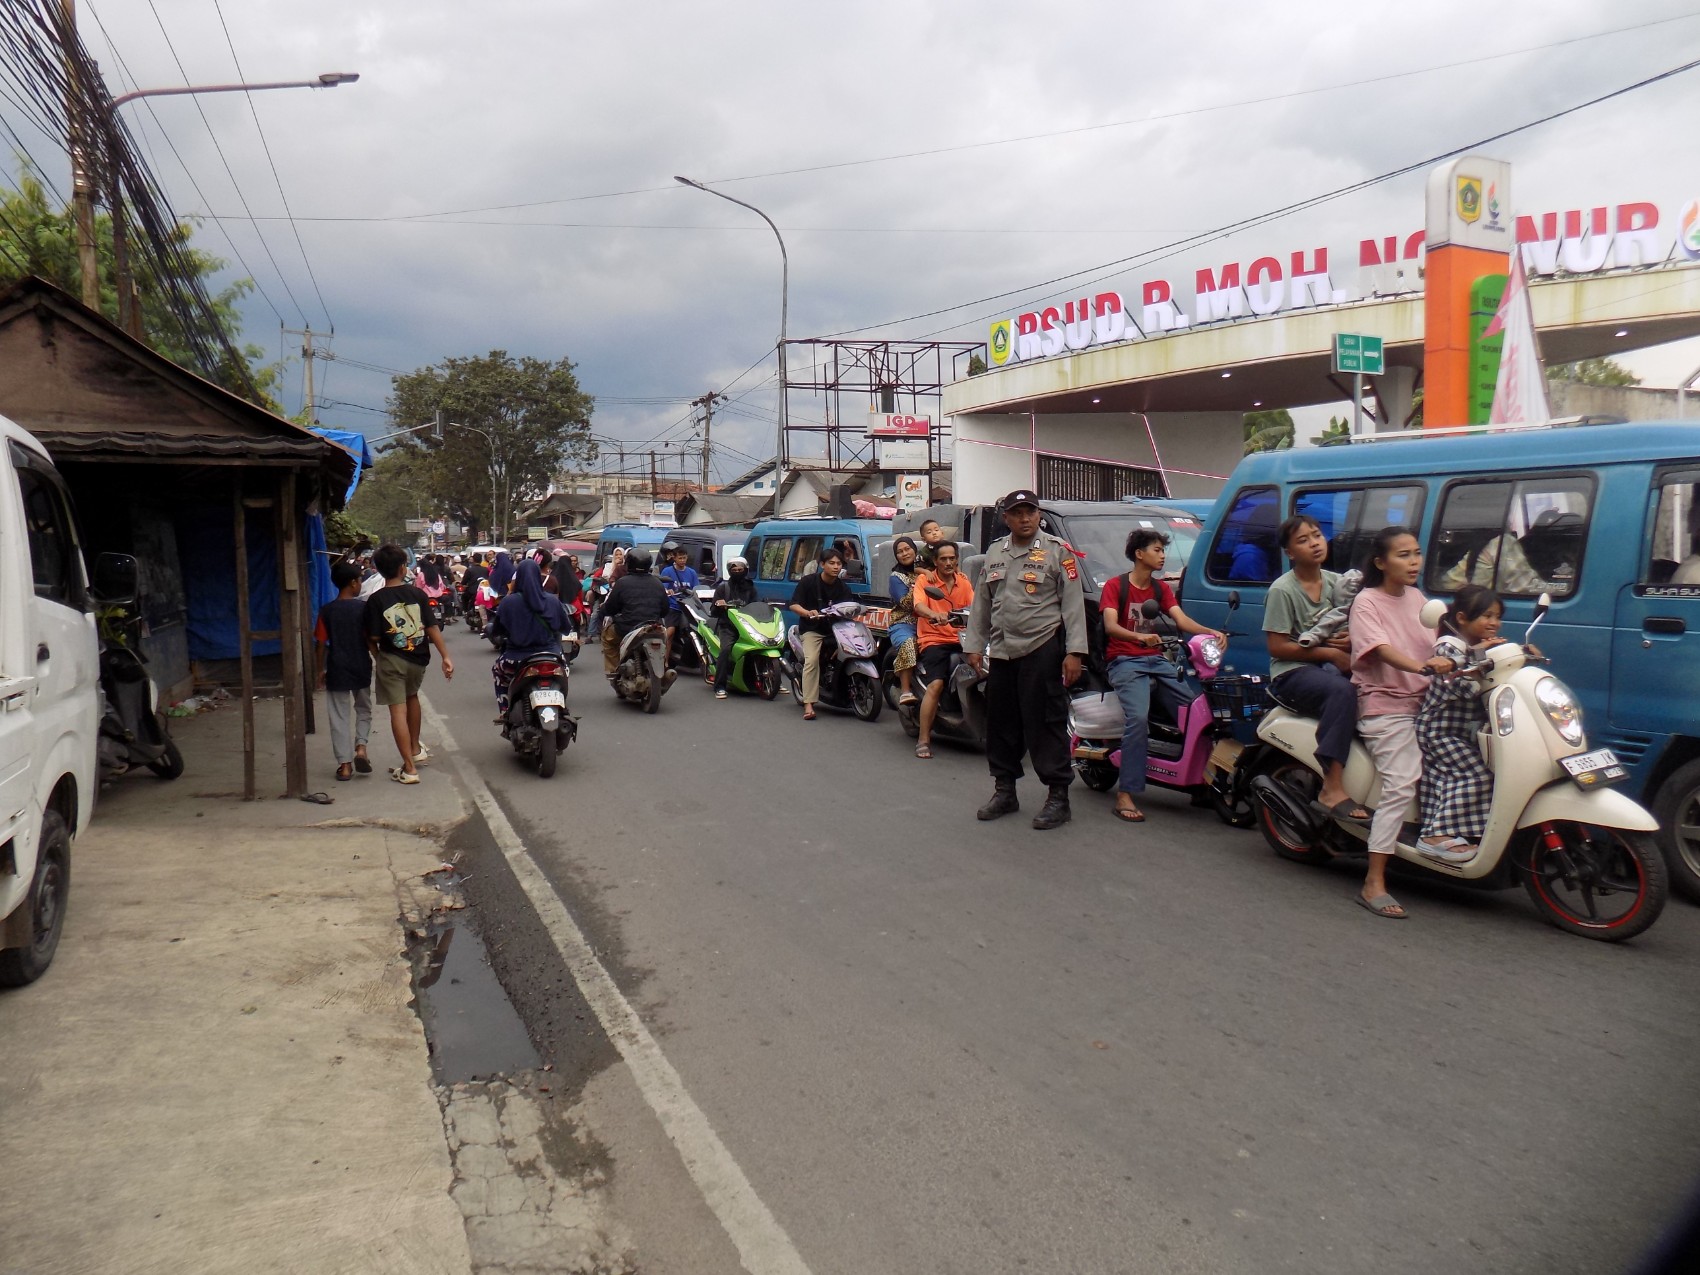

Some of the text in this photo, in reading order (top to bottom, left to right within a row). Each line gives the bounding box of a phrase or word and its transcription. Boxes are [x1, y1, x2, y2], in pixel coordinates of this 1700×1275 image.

[1142, 279, 1190, 334] R.
[1195, 246, 1347, 324] MOH.
[1515, 201, 1661, 275] NUR
[886, 414, 916, 428] IGD
[1645, 587, 1677, 595] SUKA
